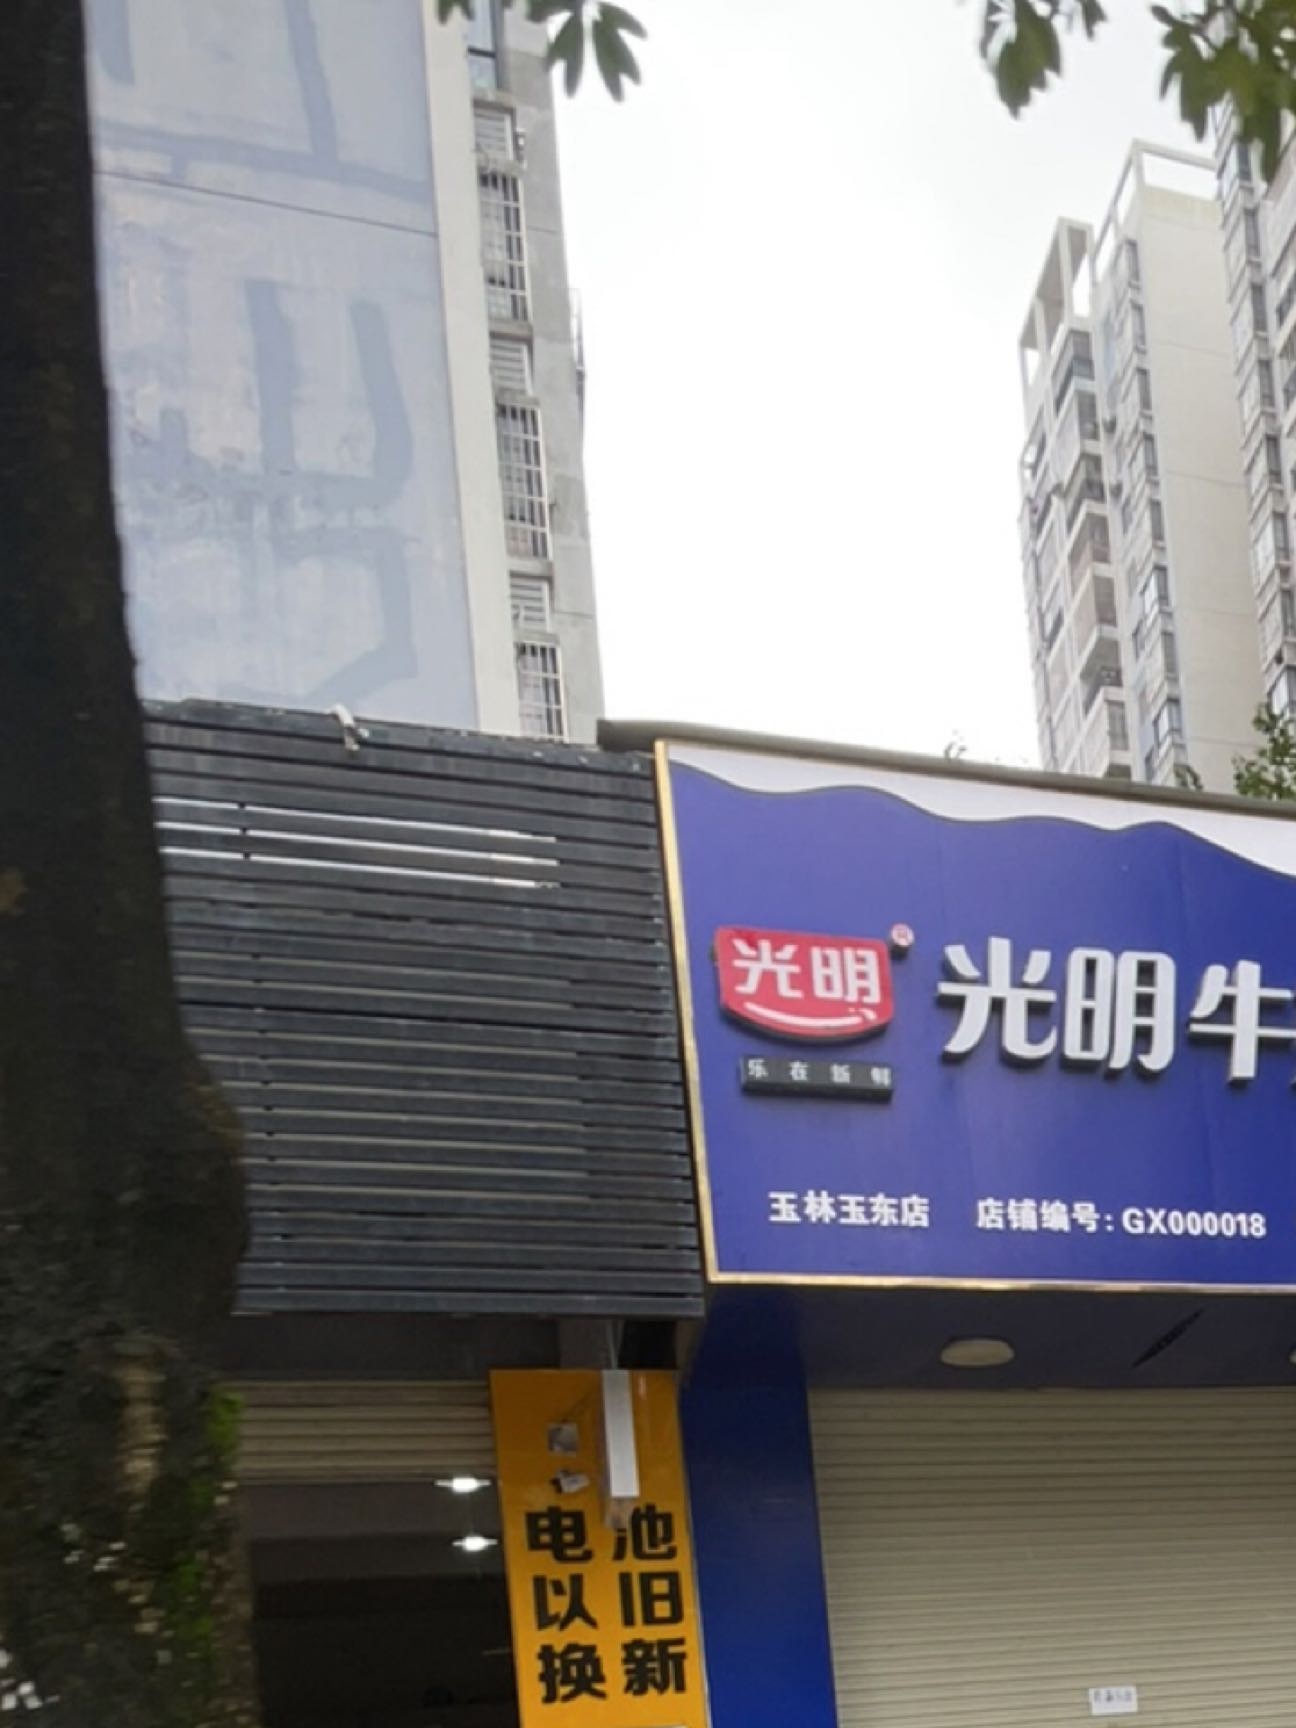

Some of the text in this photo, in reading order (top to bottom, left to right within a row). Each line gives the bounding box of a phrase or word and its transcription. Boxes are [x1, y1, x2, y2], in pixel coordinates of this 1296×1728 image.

[732, 938, 882, 1004] 光明
[768, 1190, 931, 1228] 玉林玉东店
[525, 1503, 678, 1562] 电池
[532, 1570, 684, 1631] 以旧
[537, 1638, 688, 1704] 换新
